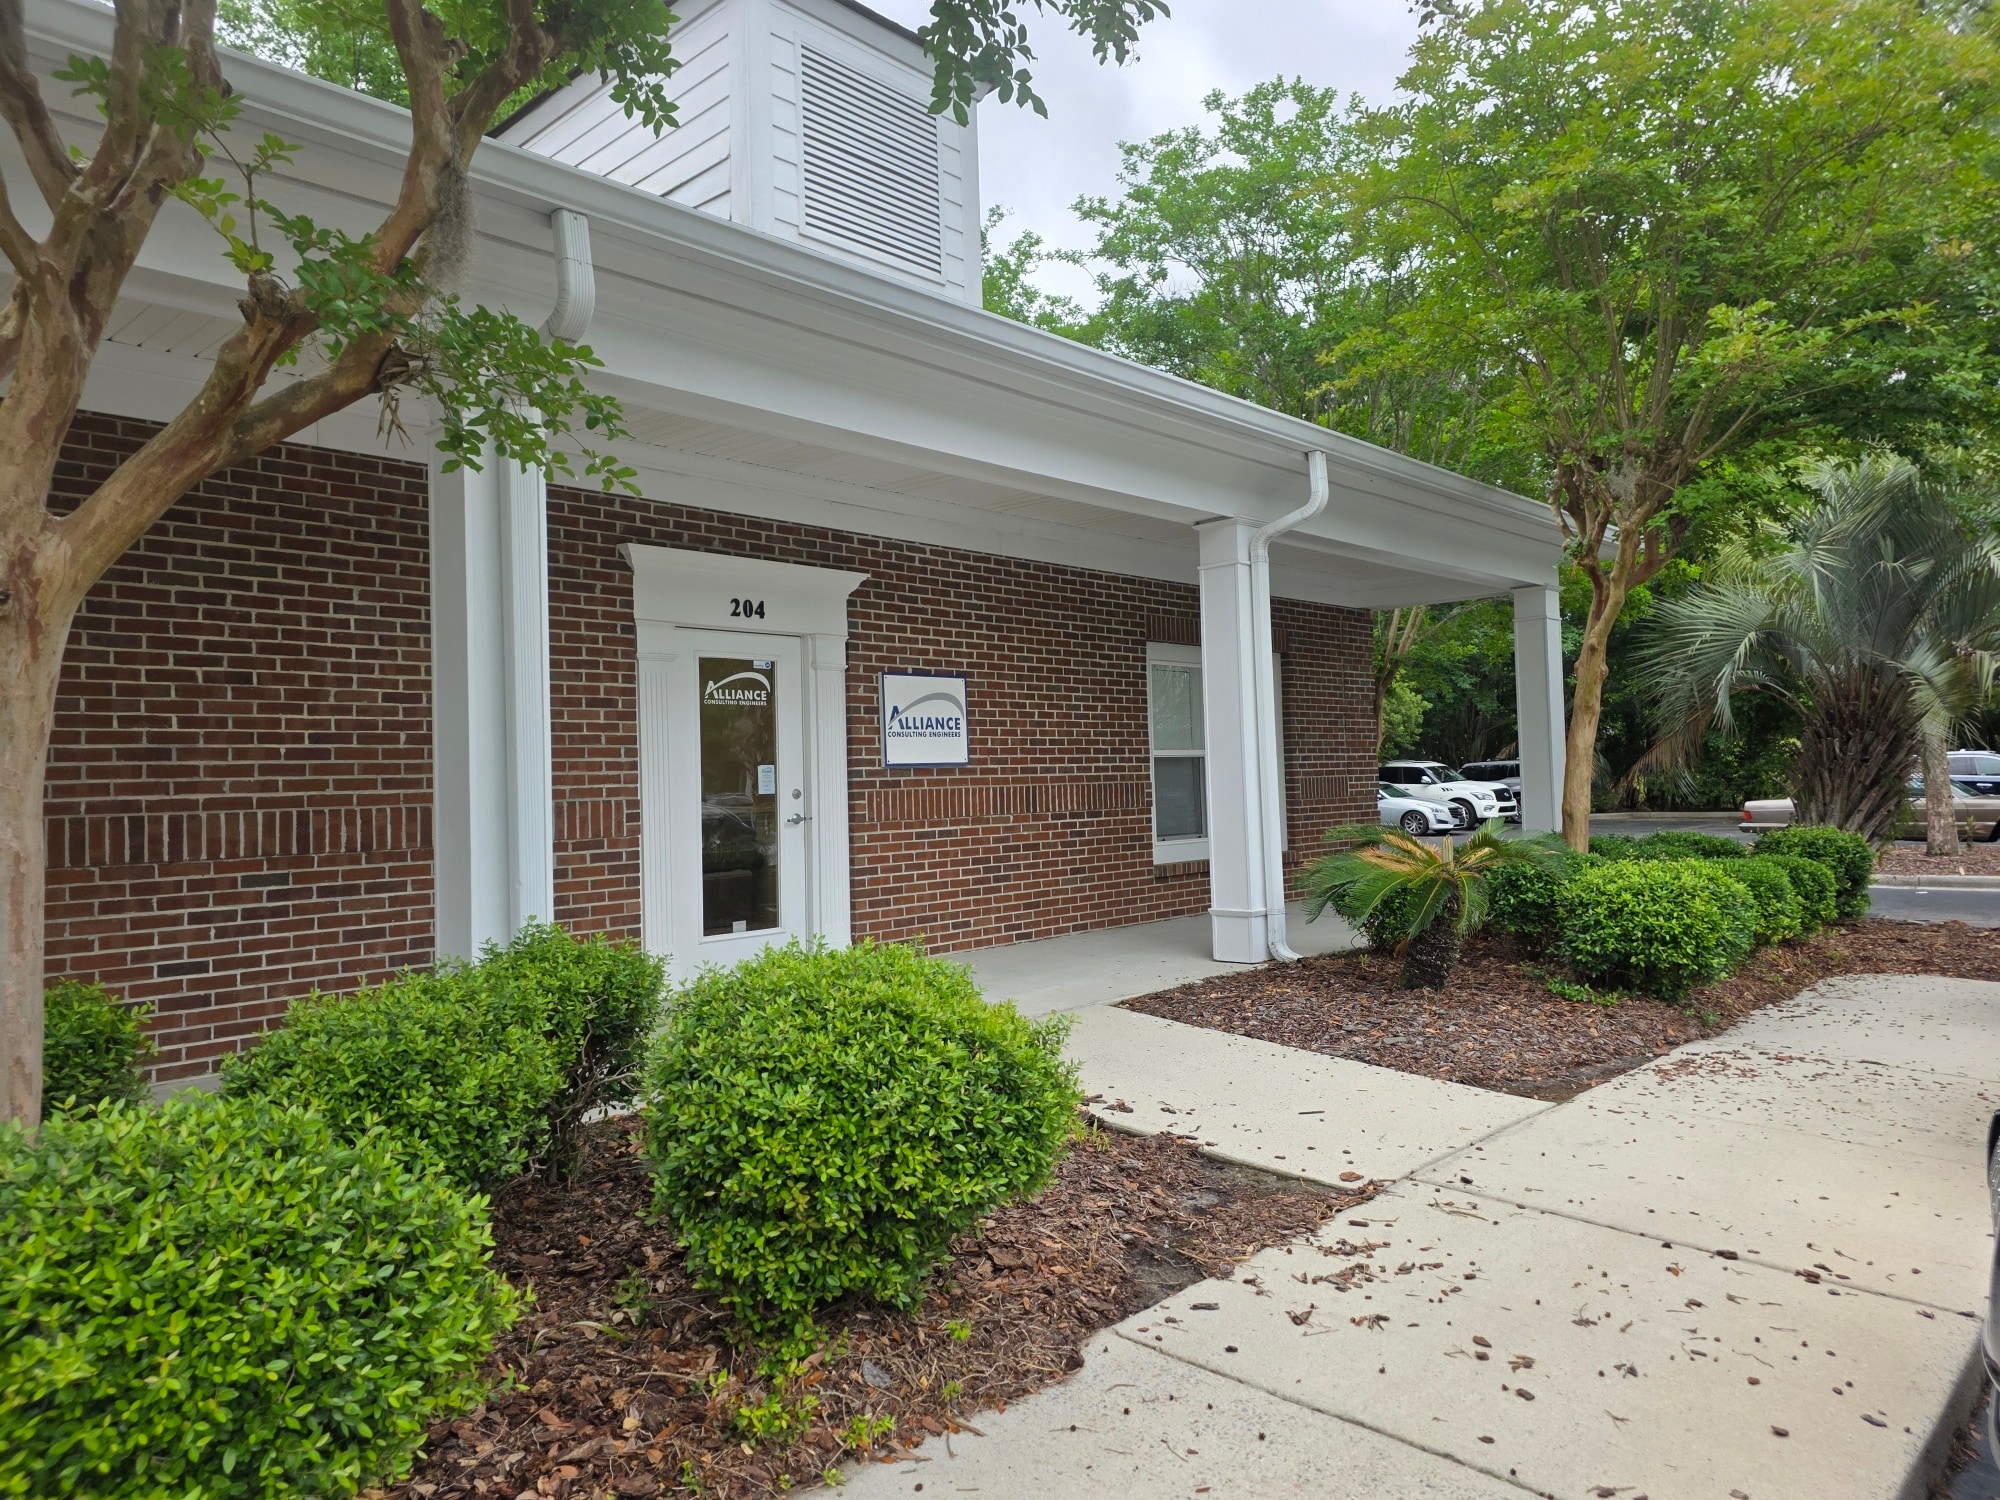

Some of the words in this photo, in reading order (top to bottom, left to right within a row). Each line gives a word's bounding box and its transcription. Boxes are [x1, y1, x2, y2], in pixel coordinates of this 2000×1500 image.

[730, 598, 765, 619] 204
[704, 680, 767, 700] ALLIANCE
[888, 705, 961, 730] ALLIANCE
